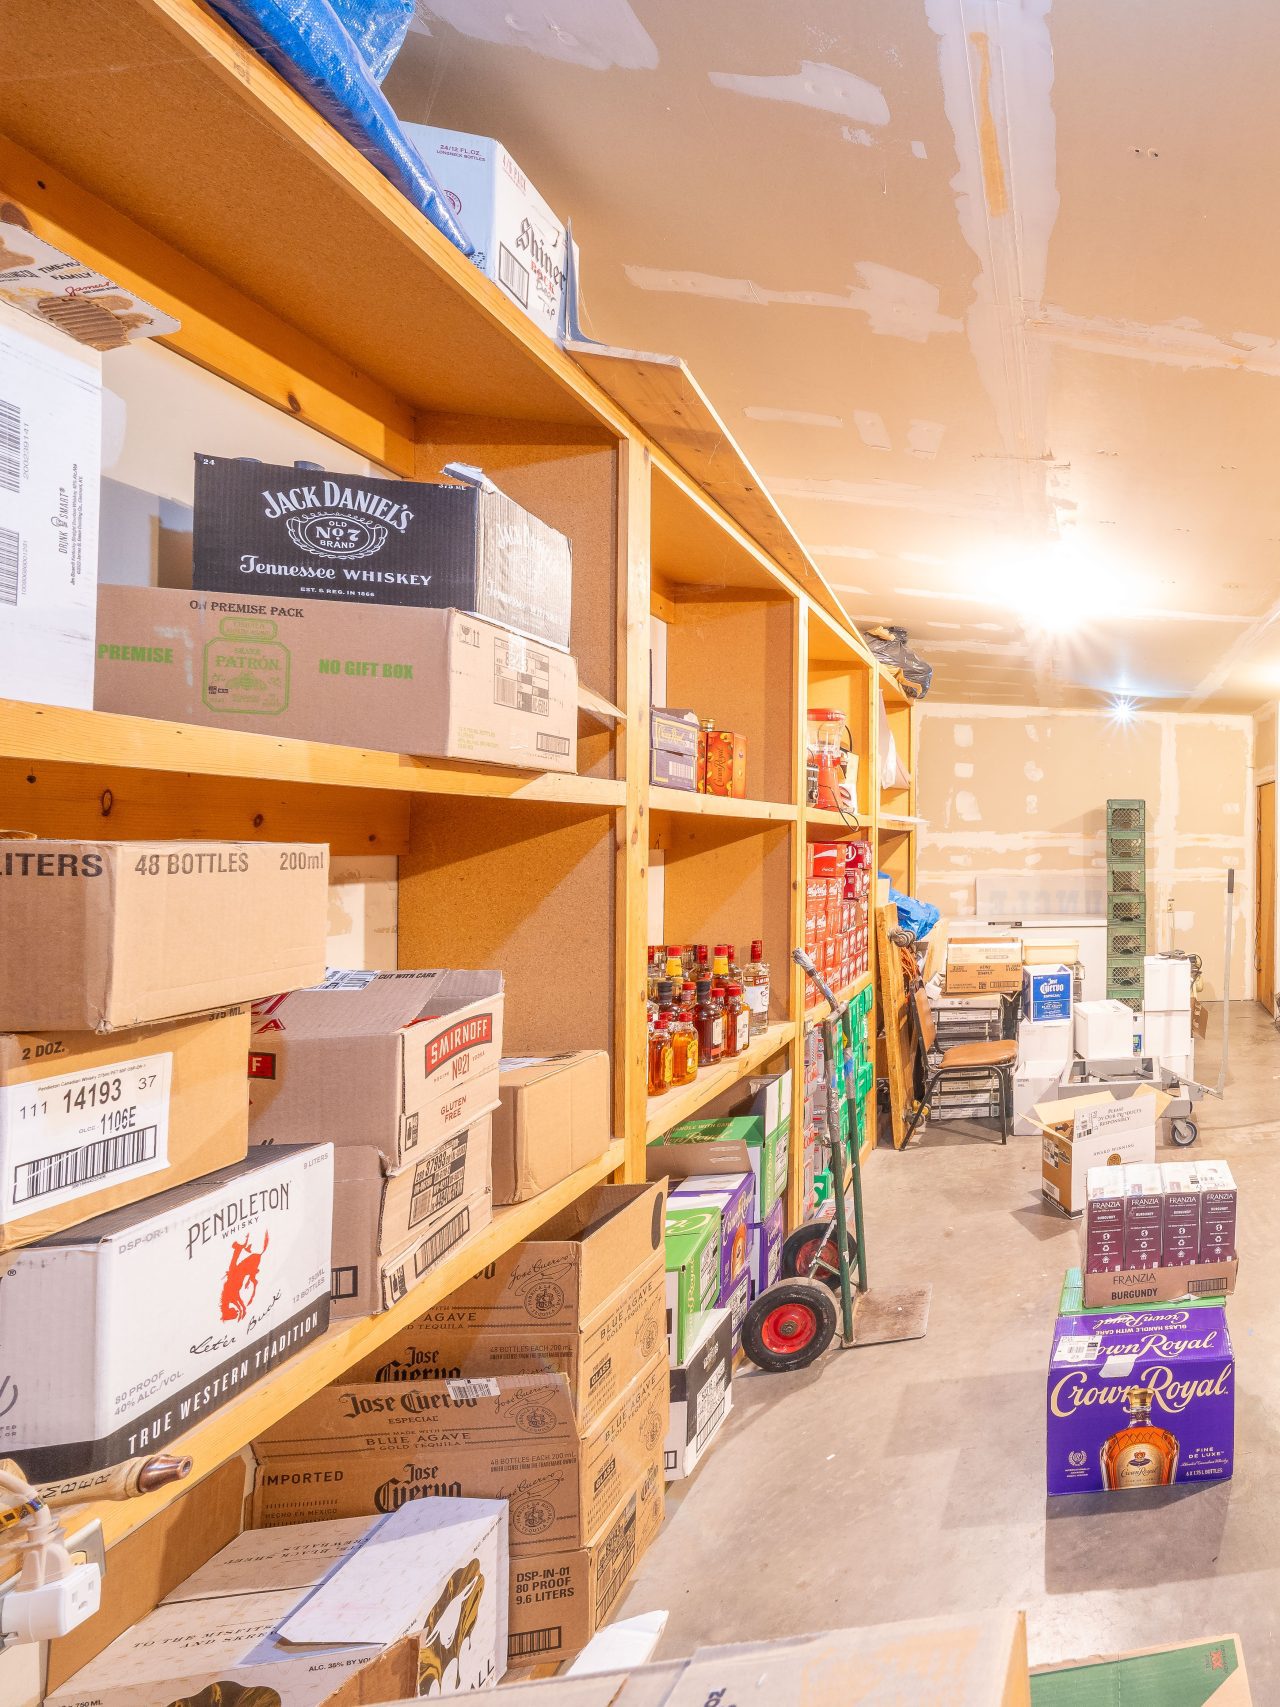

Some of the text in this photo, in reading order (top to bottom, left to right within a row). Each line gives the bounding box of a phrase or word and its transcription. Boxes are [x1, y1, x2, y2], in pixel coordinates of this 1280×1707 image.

[515, 217, 567, 292] Shiner
[203, 458, 216, 466] 24
[261, 485, 323, 520] JACK
[328, 520, 348, 529] OLD
[58, 531, 69, 554] DRINK
[320, 539, 356, 550] BRAND
[347, 528, 361, 543] 7
[239, 554, 337, 581] Tennessee
[343, 568, 433, 586] WHISKEY
[300, 586, 345, 596] EST. REG.
[210, 600, 267, 616] PREMISE
[270, 605, 305, 619] PACK
[97, 643, 174, 665] PREMISE
[318, 657, 415, 681] NO GIFT BOX
[0, 853, 104, 879] ITERS
[135, 850, 325, 877] 48 BOTTLES 200ml
[378, 971, 438, 981] CUT WITH CARE
[21, 1041, 66, 1061] 2 DOZ.
[430, 1018, 489, 1066] SMIRNOFF
[63, 1075, 157, 1114] 14193 37
[440, 1094, 468, 1116] GLUTEN
[444, 1106, 463, 1124] FREE
[308, 1153, 329, 1169] LITERS
[1092, 1201, 1121, 1209] FRANZIA
[1131, 1197, 1160, 1206] FRANZIA
[1169, 1196, 1197, 1205] FRANZIA
[1206, 1192, 1234, 1201] FRANZIA
[185, 1182, 290, 1261] PENDLETON
[222, 1215, 261, 1240] WHISKY
[300, 1277, 326, 1300] BOTTLES
[1112, 1272, 1157, 1287] FRANZIA
[1111, 1287, 1158, 1301] BURGUNDY
[424, 1312, 477, 1323] AGAVE
[600, 1280, 654, 1340] BLUE AGAVE
[416, 1323, 465, 1331] TEQUILA
[530, 1344, 549, 1352] EACH
[1140, 1331, 1218, 1358] Royal
[127, 1310, 319, 1456] TRUE WESTERN TRADITION
[128, 1369, 166, 1397] PROOF
[1050, 1363, 1232, 1418] Crown Royal
[338, 1390, 397, 1420] Jose
[604, 1375, 657, 1441] BLUE AGAVE
[366, 1432, 471, 1446] BLUE AGAVE
[379, 1441, 462, 1451] GOLD TEQUILA
[499, 1452, 564, 1465] BOTTLES EACH 200
[261, 1470, 344, 1487] IMPORTED
[403, 1463, 440, 1484] Jose
[516, 1566, 571, 1583] DSP-IN-01
[515, 1576, 572, 1595] 80 PROOF
[515, 1586, 575, 1606] 9.6 LITERS
[308, 1663, 327, 1673] ALC.
[346, 1658, 358, 1667] BY
